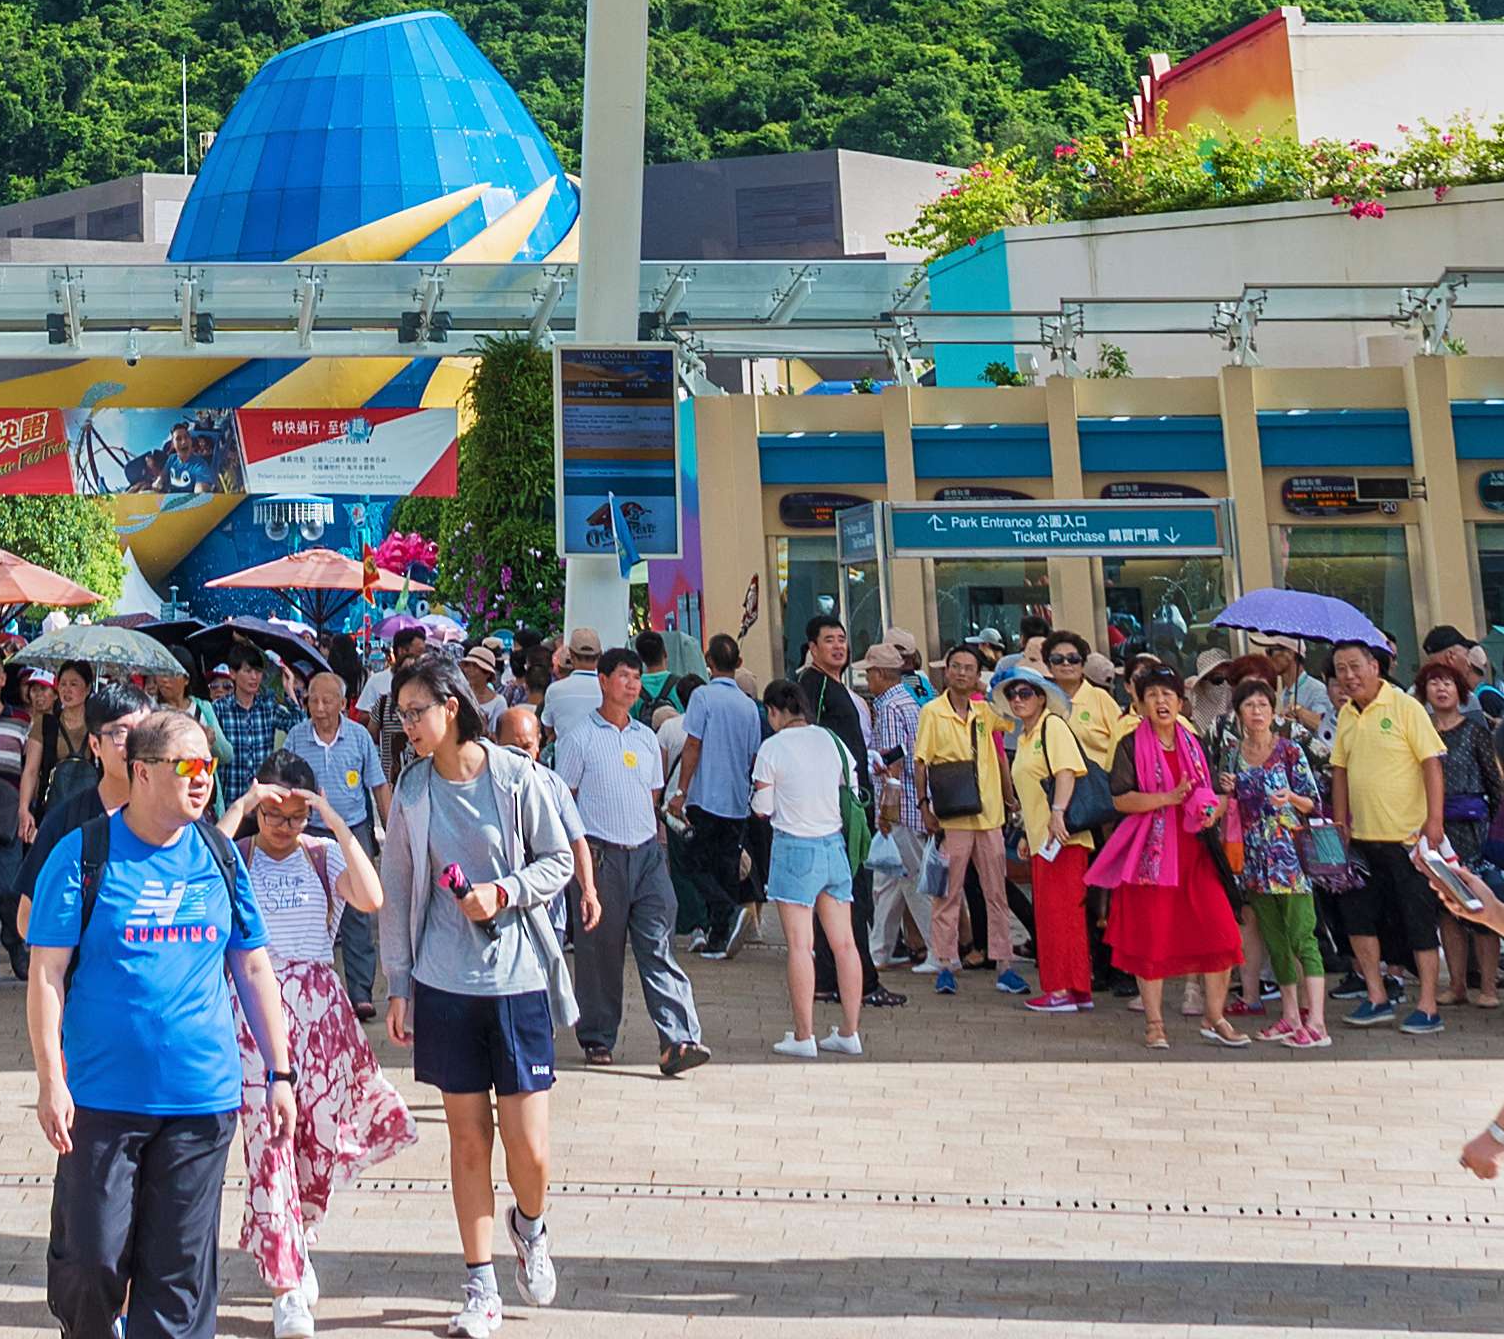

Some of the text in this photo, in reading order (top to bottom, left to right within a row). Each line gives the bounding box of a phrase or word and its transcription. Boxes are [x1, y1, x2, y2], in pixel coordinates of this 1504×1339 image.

[1382, 501, 1398, 513] 20
[951, 514, 1088, 529] Park Entrance 公園入口
[1012, 527, 1160, 543] Ticket Purchase 購買門票
[124, 925, 218, 943] RUNNING
